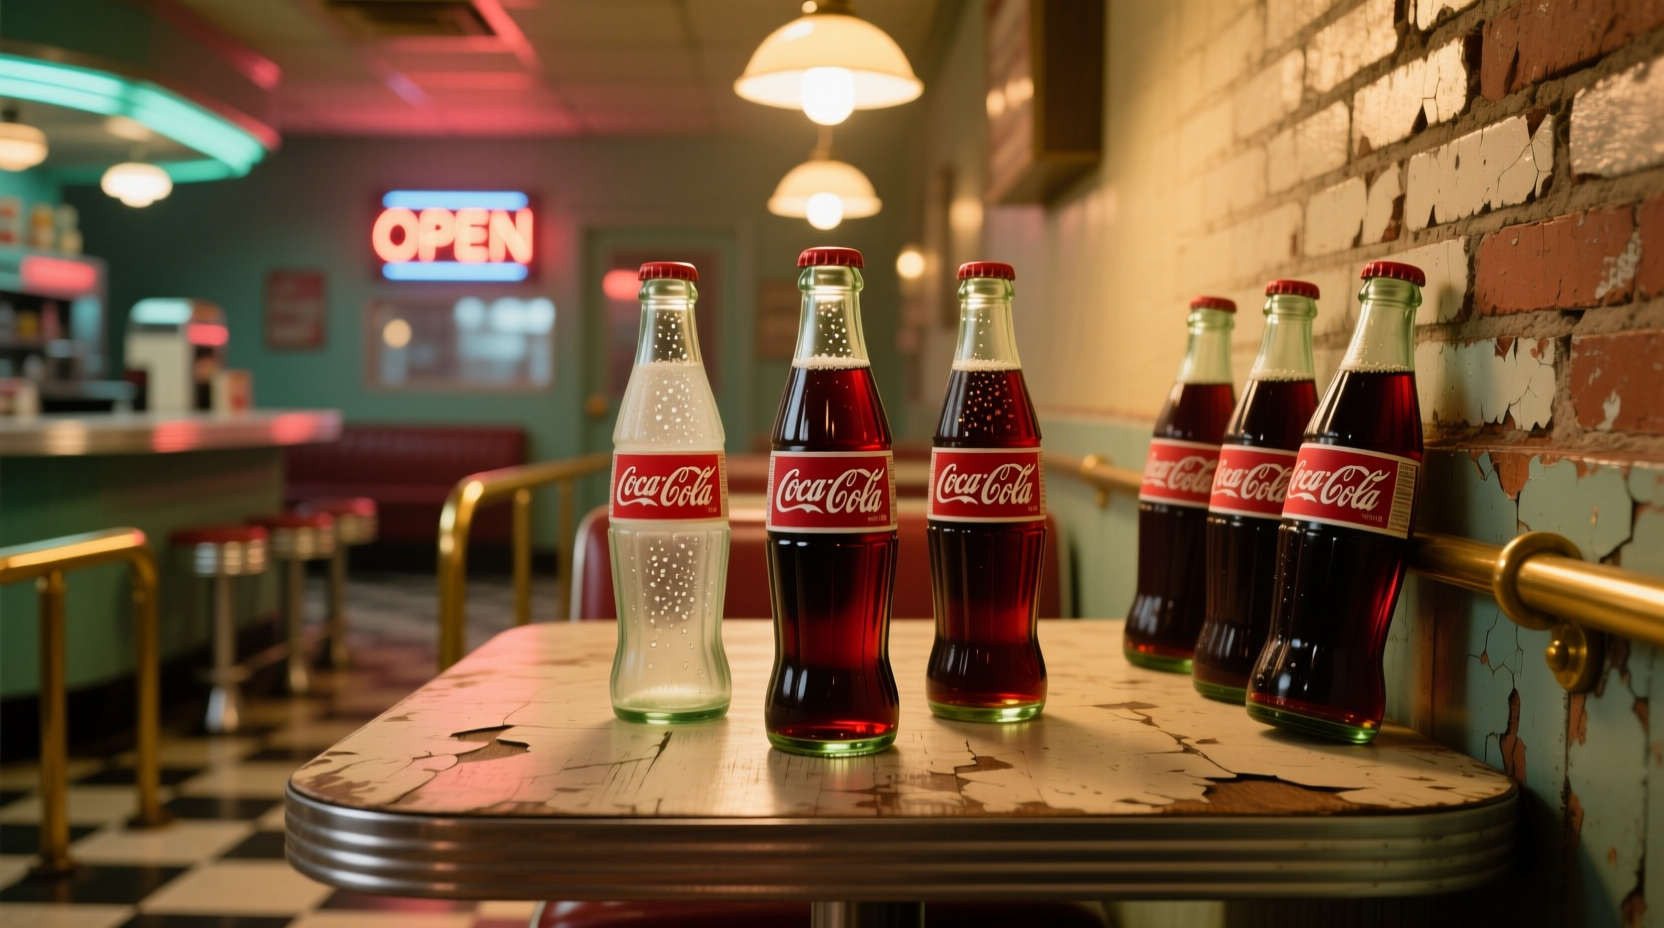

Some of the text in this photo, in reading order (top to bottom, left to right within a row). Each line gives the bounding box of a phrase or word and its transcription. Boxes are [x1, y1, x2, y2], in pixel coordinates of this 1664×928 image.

[371, 206, 534, 265] OPEN
[616, 465, 716, 507] Coca-Cola
[775, 467, 885, 514] Coca-Cola
[936, 463, 1036, 505] Coca-Cola
[1287, 459, 1391, 512] Coca-Cola
